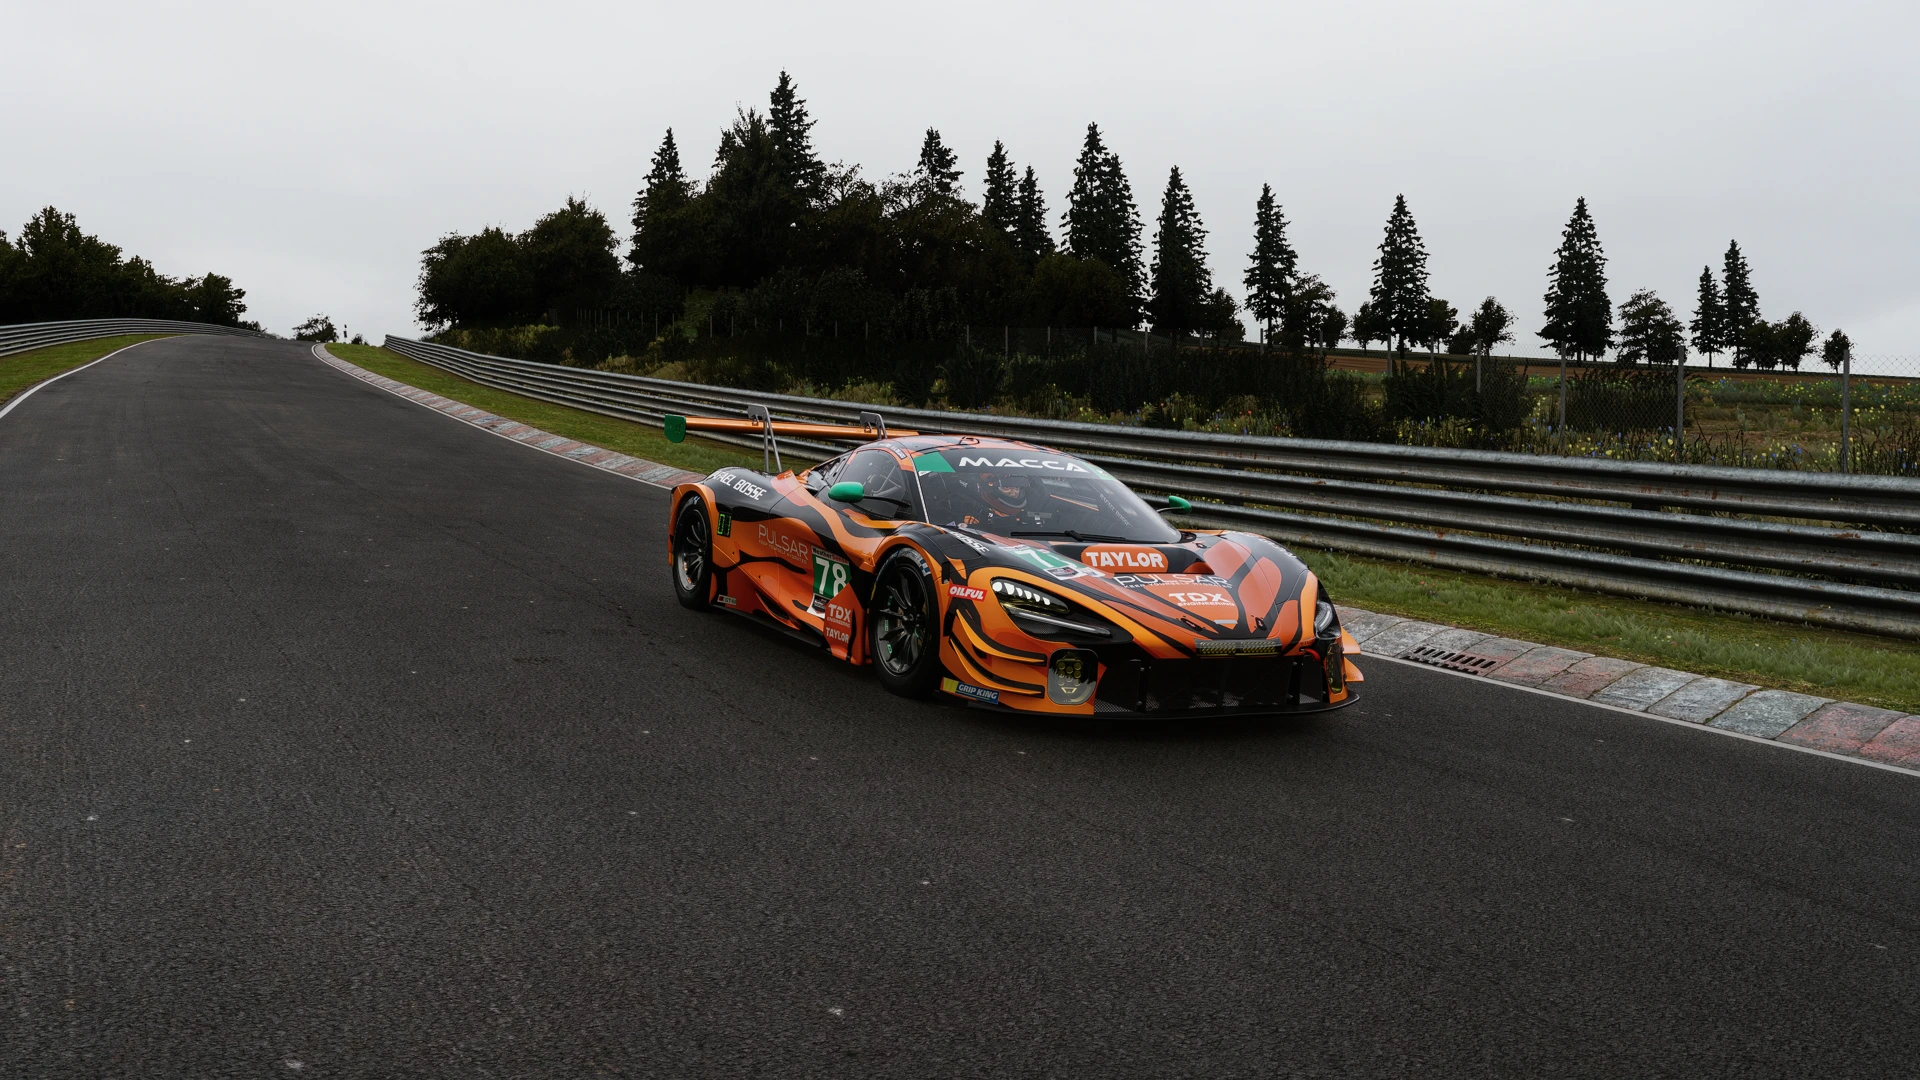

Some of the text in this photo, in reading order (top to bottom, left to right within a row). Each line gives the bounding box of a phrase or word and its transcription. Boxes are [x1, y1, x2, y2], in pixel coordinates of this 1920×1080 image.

[959, 457, 1089, 473] MACCA
[733, 479, 767, 500] BOSSE
[758, 523, 808, 560] PULSAR
[1085, 551, 1164, 568] TAYLOR
[816, 556, 846, 597] 78
[1113, 574, 1229, 586] PULSAR
[949, 586, 984, 600] OILFUL
[1168, 592, 1230, 603] TDX
[828, 603, 852, 623] TDX
[826, 627, 849, 643] TAYLOR
[958, 684, 998, 699] GRIP KING
